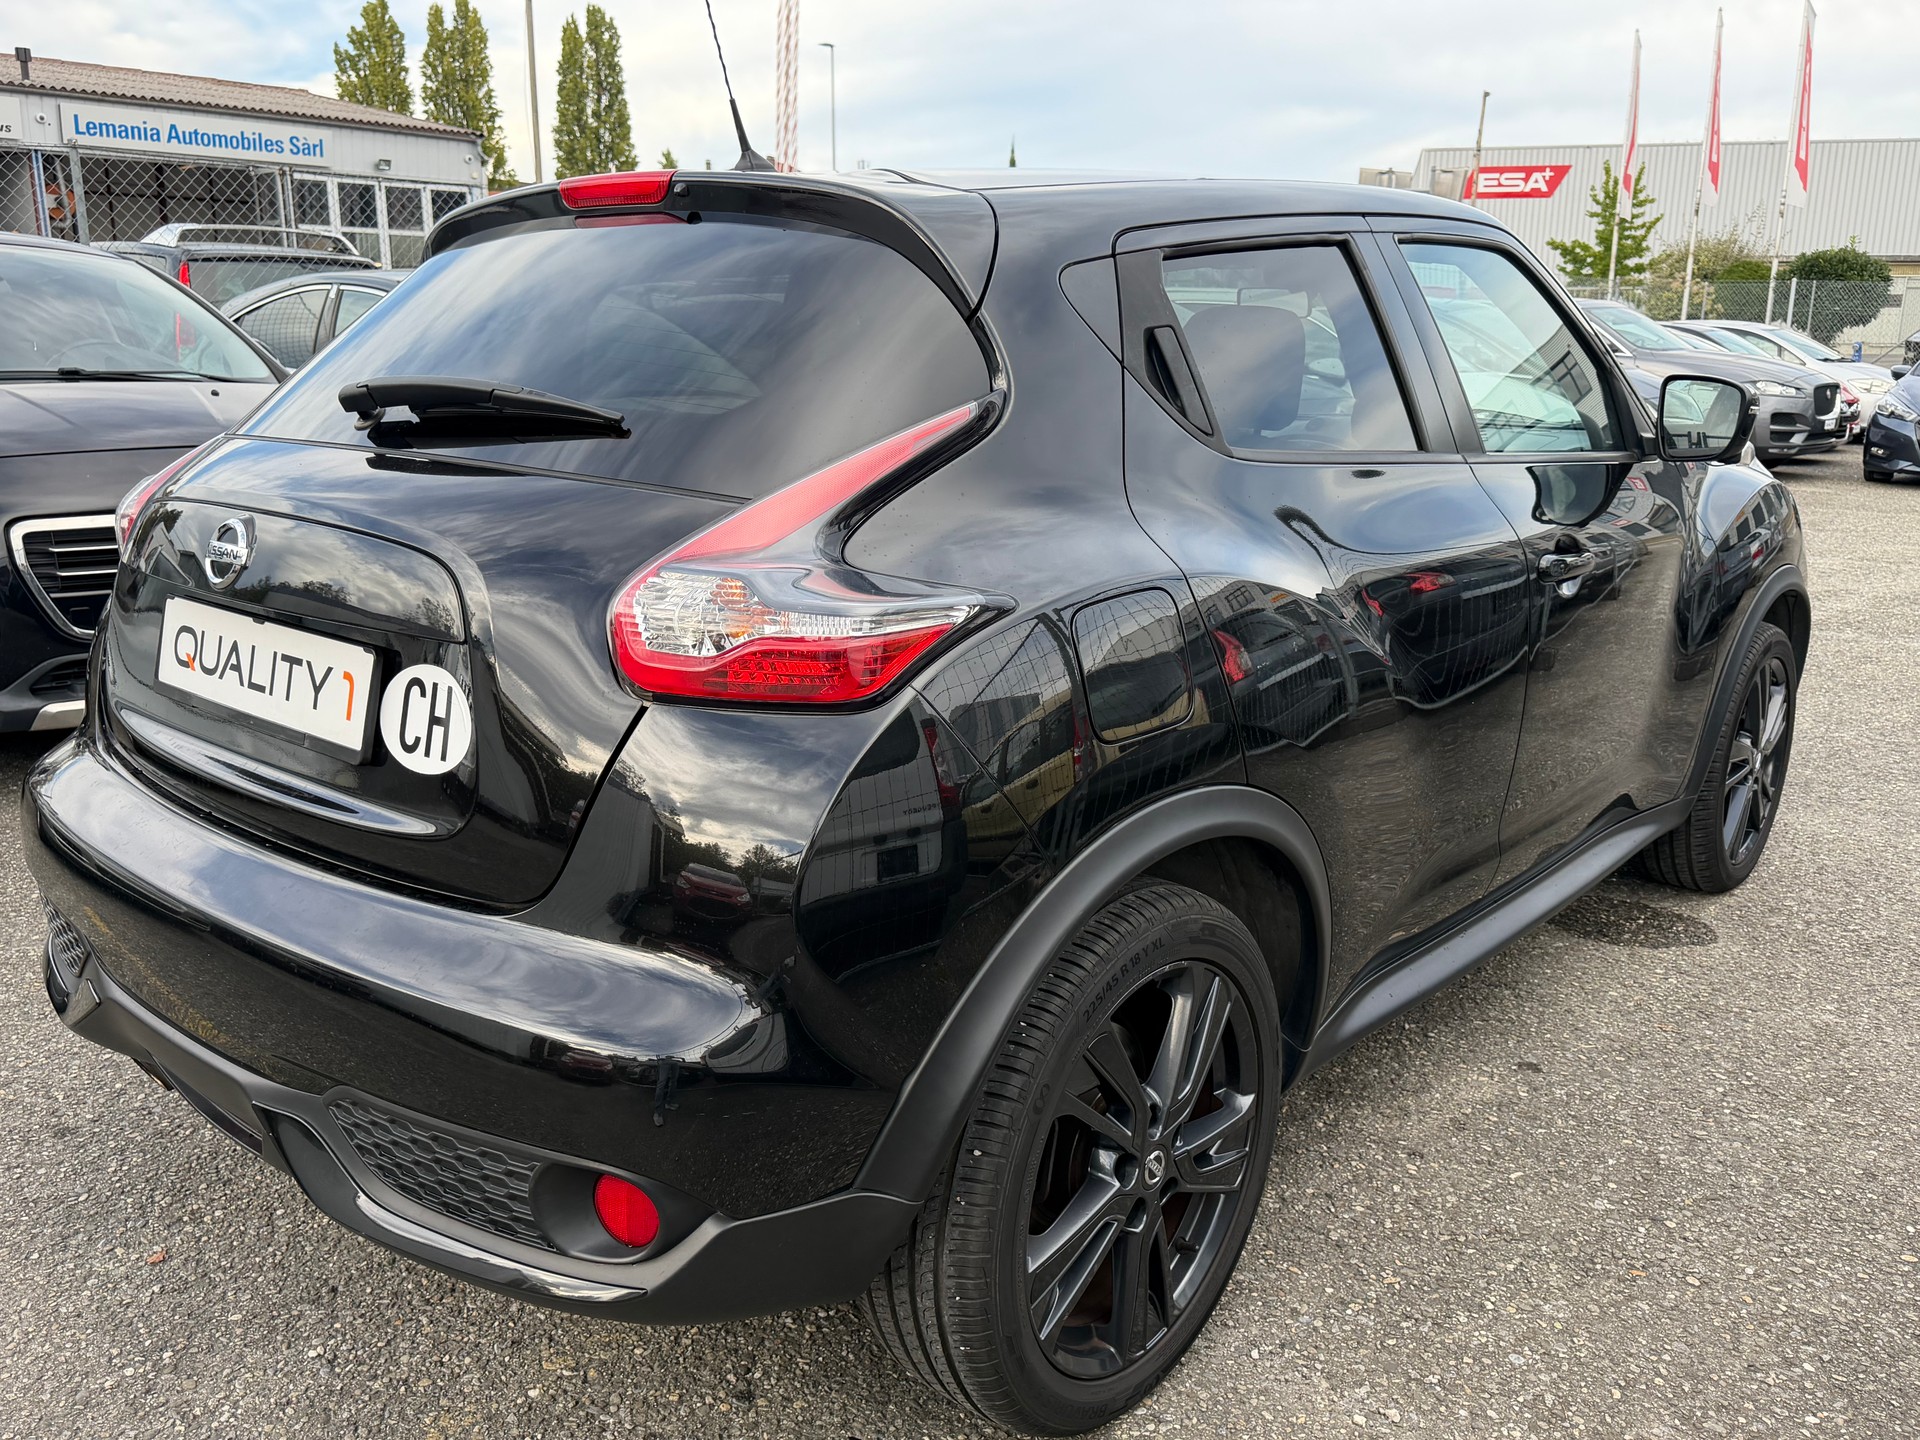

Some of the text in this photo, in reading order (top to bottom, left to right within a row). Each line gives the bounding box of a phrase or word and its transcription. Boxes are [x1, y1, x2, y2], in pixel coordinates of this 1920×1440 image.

[73, 113, 324, 158] Lemania Automobiles Sàrl
[174, 625, 334, 711] QUALITY
[400, 676, 454, 762] CH
[1083, 973, 1119, 1022] 225/45
[1120, 964, 1129, 977] R
[1129, 952, 1141, 968] 18
[1142, 945, 1150, 957] Y
[1151, 937, 1166, 953] XL
